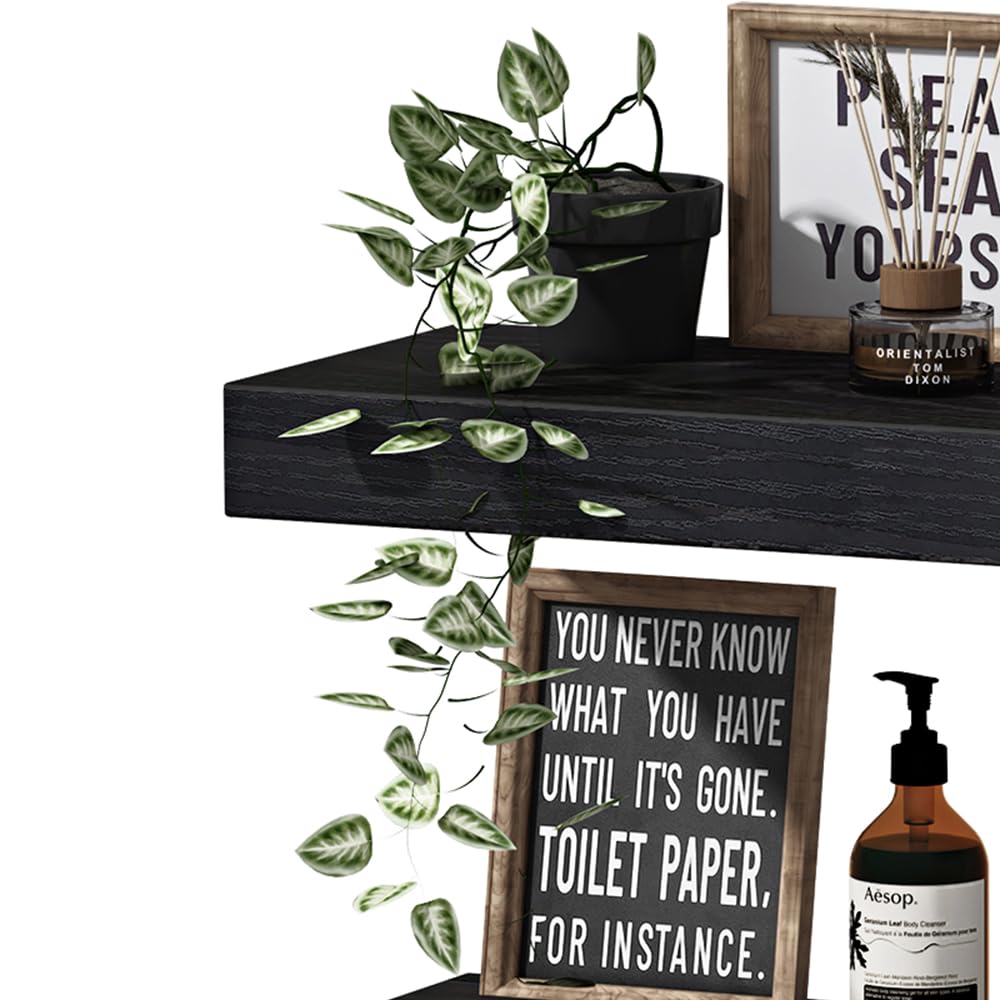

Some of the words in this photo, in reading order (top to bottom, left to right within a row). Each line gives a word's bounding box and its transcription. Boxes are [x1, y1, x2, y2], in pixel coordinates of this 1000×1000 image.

[876, 346, 975, 359] ORIENTALIST
[905, 375, 951, 385] DIXON
[912, 363, 943, 373] TOM
[556, 611, 608, 662] YOU
[614, 615, 703, 669] NEVER
[710, 622, 792, 675] KNOW
[550, 683, 627, 735] WHAT
[647, 690, 698, 740] YOU
[714, 695, 786, 747] HAVE
[541, 753, 620, 806] UNTIL
[634, 761, 683, 812] IT'S
[696, 765, 777, 818] GONE.
[538, 826, 648, 899] TOILET
[659, 834, 771, 909] PAPER,
[528, 915, 588, 966] FOR
[601, 920, 765, 981] INSTANCE.
